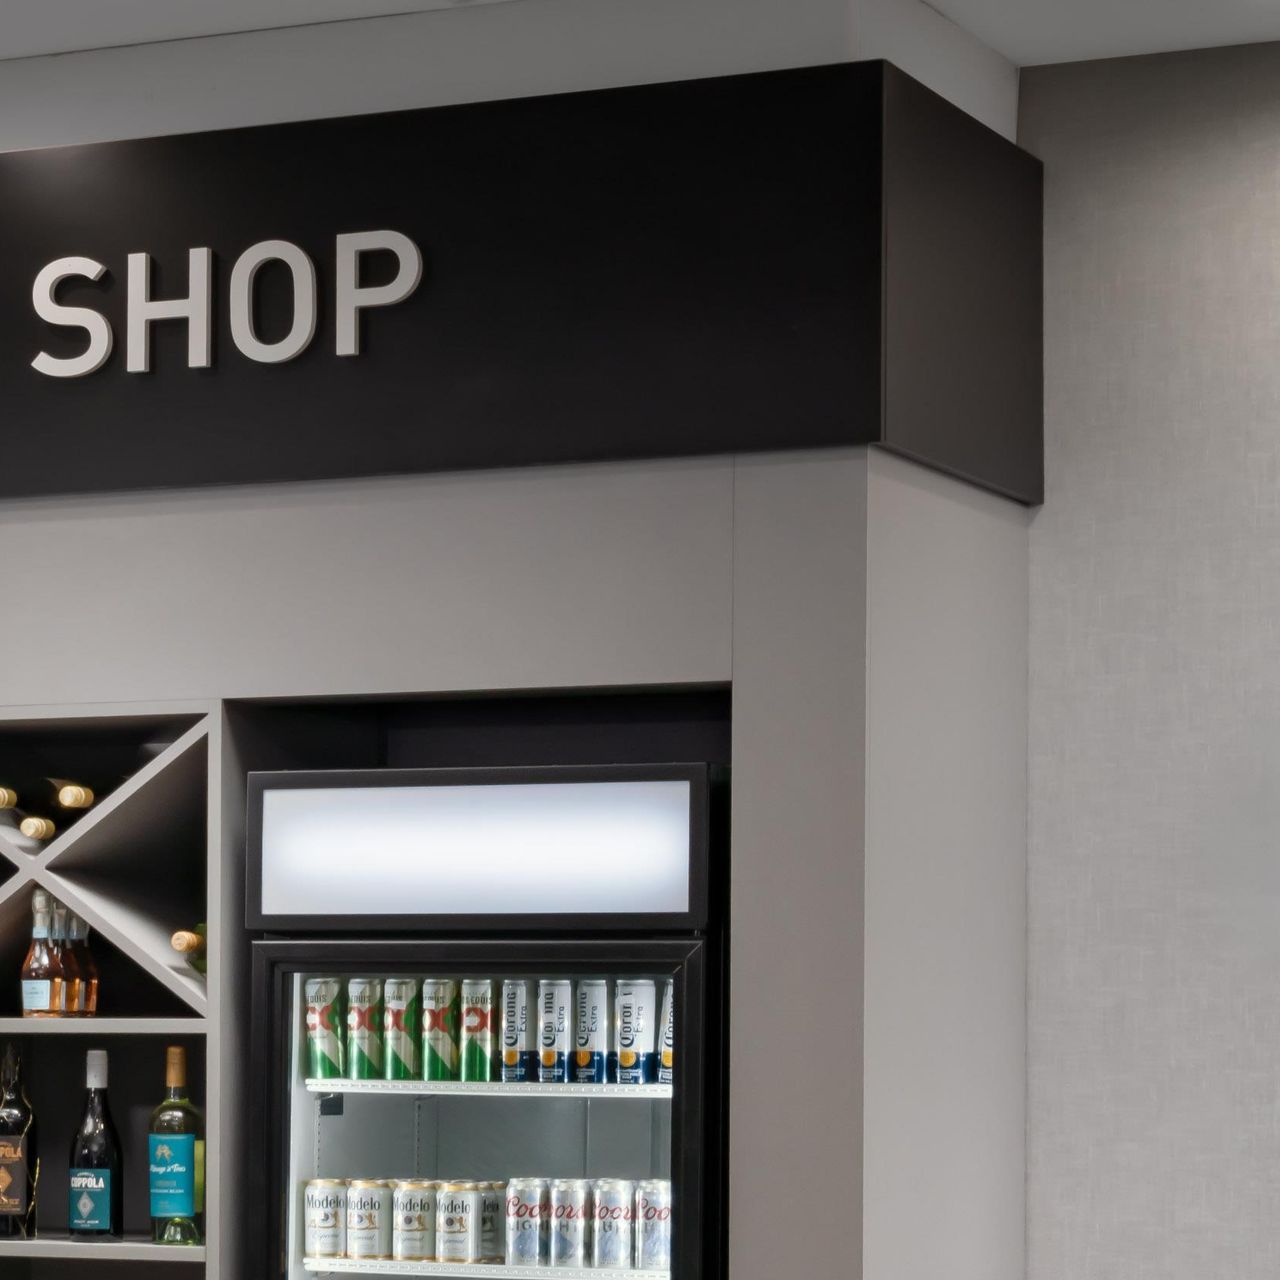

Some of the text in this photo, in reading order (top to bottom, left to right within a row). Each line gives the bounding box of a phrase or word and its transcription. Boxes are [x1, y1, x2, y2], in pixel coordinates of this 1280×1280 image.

[30, 229, 423, 378] SHOP
[518, 1005, 528, 1033] Extra
[557, 1005, 565, 1033] Extra
[590, 1005, 598, 1033] Extra
[70, 1176, 105, 1189] COPPOLA
[306, 1194, 345, 1209] Modelo
